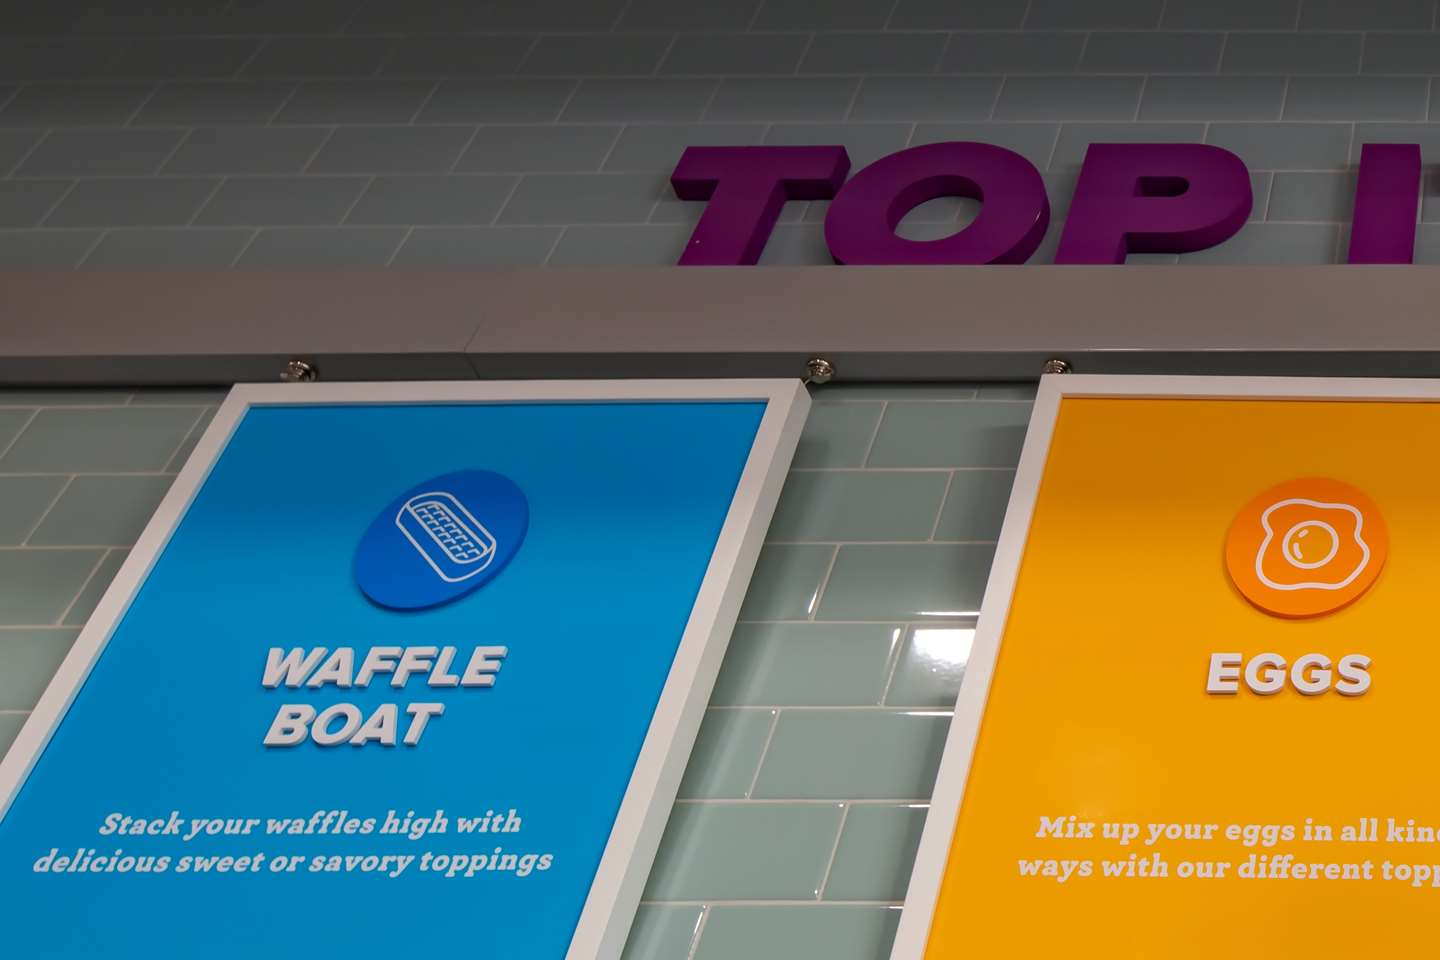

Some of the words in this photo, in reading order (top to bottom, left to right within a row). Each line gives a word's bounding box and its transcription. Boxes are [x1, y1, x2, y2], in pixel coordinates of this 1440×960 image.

[670, 141, 1253, 266] TOP
[261, 645, 508, 689] WAFFLE
[1206, 652, 1372, 696] EGGS
[263, 702, 445, 748] BOAT
[98, 811, 185, 836] Stack
[183, 818, 261, 841] your
[266, 810, 377, 835] waffles
[379, 810, 449, 841] high
[457, 808, 522, 834] with
[1035, 815, 1095, 839] Mix
[1102, 822, 1140, 846] up
[1144, 823, 1219, 847] your
[1225, 824, 1296, 848] eggs
[1303, 817, 1333, 842] in
[1340, 817, 1379, 842] all
[32, 847, 171, 874] delicious
[175, 852, 266, 873] sweet
[269, 855, 306, 872] or
[308, 855, 415, 879] savory
[419, 847, 555, 878] toppings
[1018, 859, 1094, 884] ways
[1101, 852, 1169, 878] with
[1176, 861, 1231, 879] our
[1237, 854, 1374, 881] different
